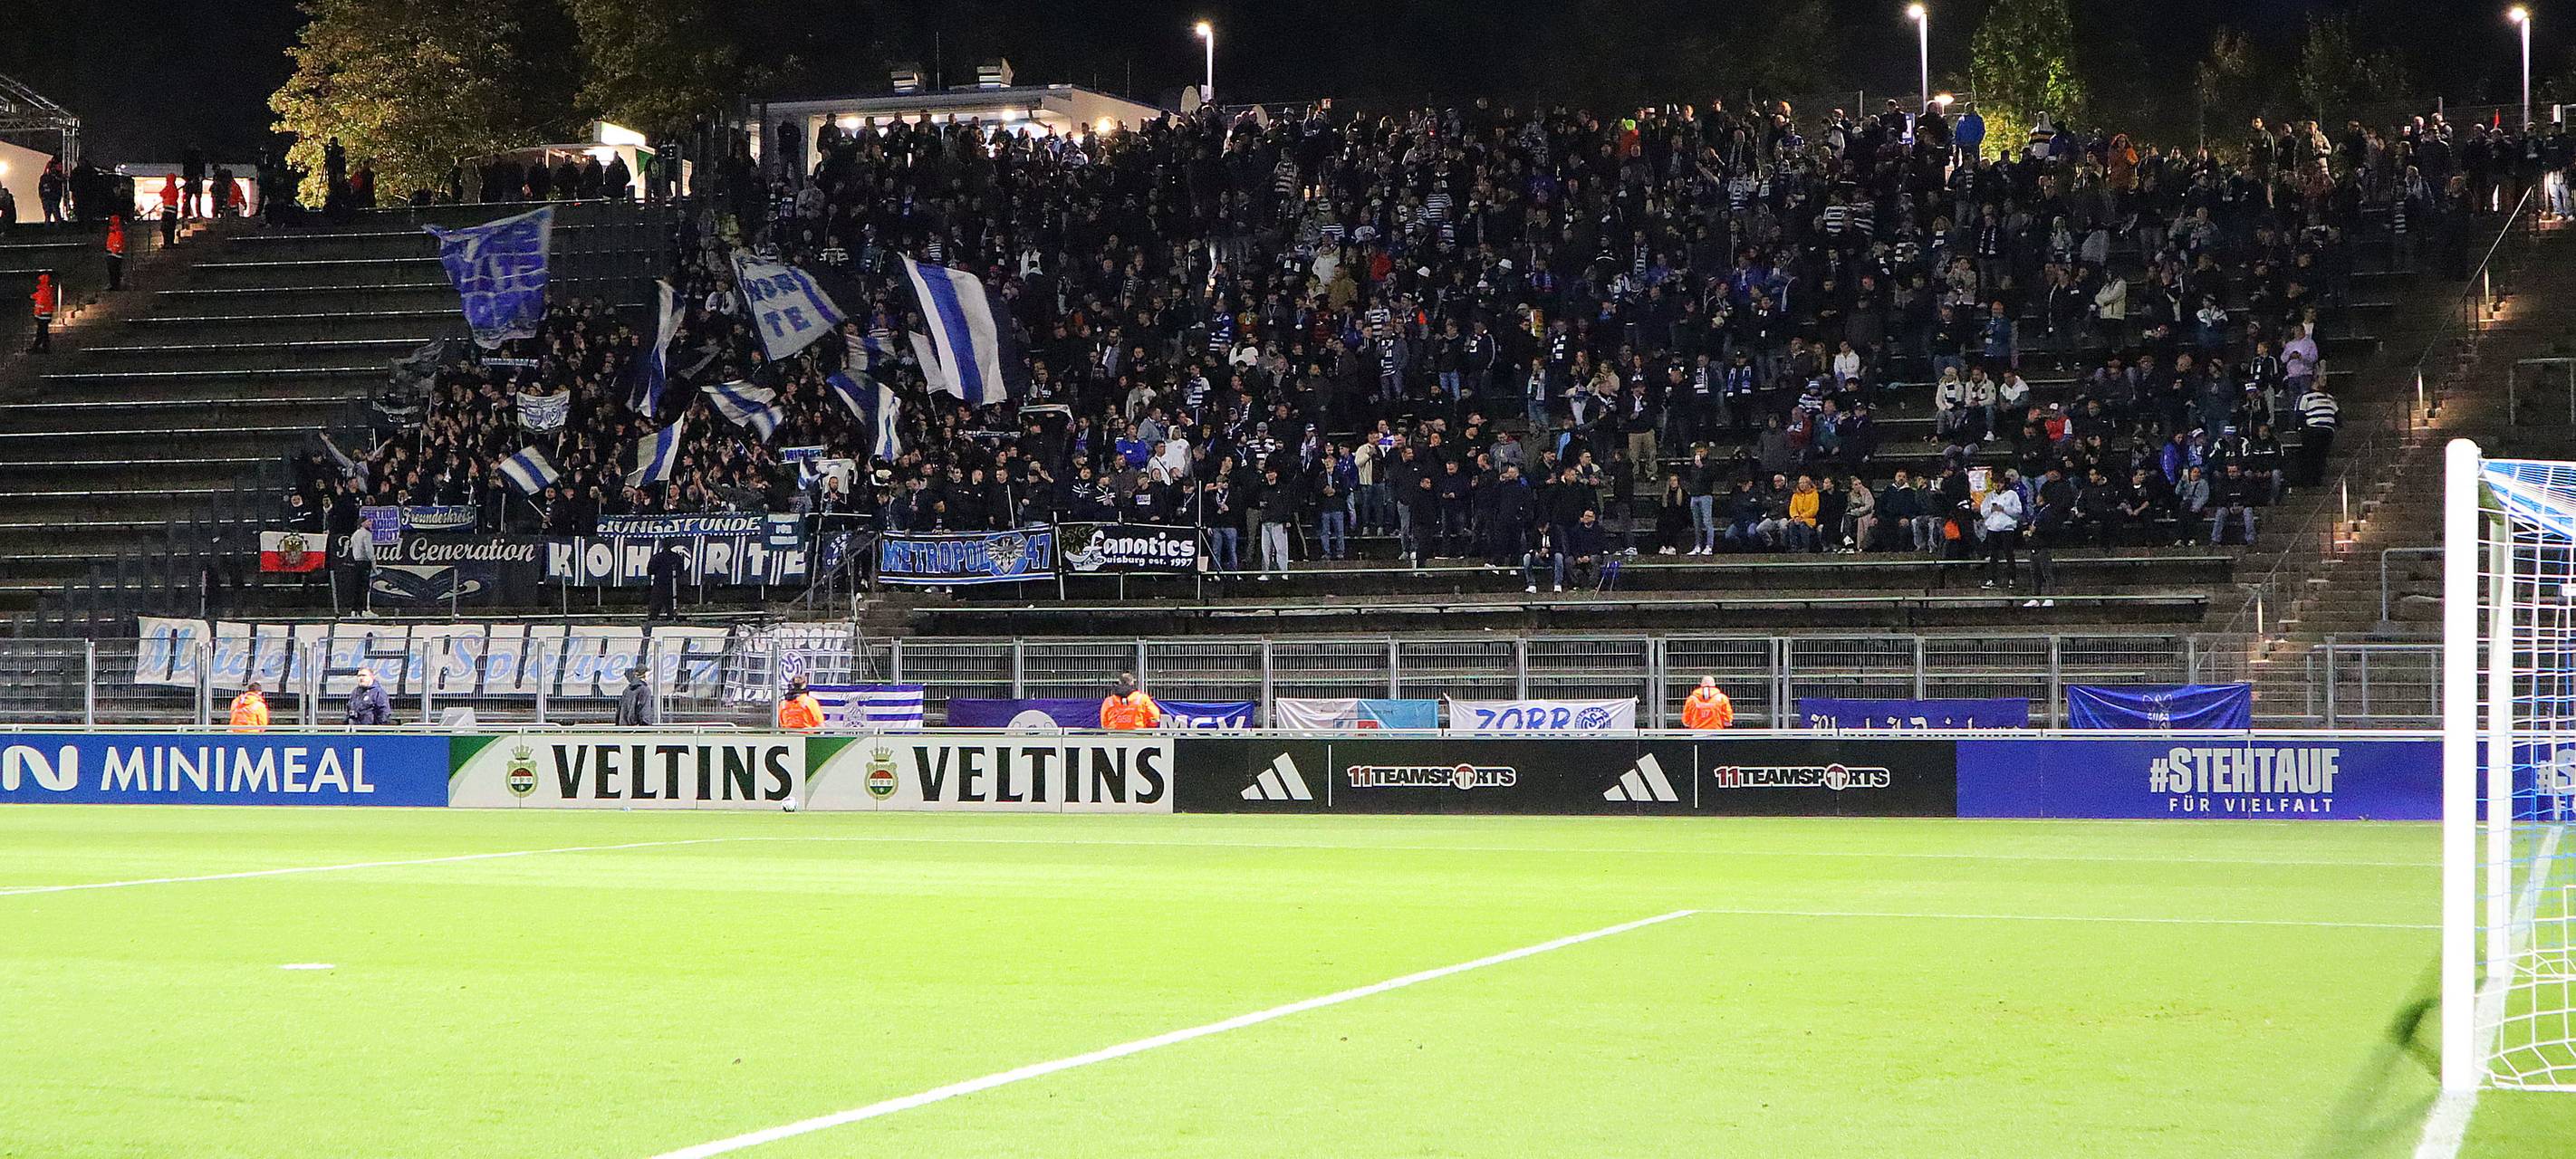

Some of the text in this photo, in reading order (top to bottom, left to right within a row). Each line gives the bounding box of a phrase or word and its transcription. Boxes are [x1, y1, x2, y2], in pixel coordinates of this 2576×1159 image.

[401, 507, 474, 525] Freundeskreis
[336, 535, 535, 564] Pud Generation
[881, 540, 991, 574] METROPOL
[1026, 532, 1053, 570] 47
[1065, 530, 1196, 565] Fanatics
[1170, 558, 1193, 567] 1997
[100, 746, 374, 793] MINIMEAL
[551, 744, 793, 801] VELTINS
[912, 746, 1165, 804] VELTINS
[2149, 747, 2341, 794] #STEHTAUF
[2169, 795, 2333, 812] FÜR VIELFALT
